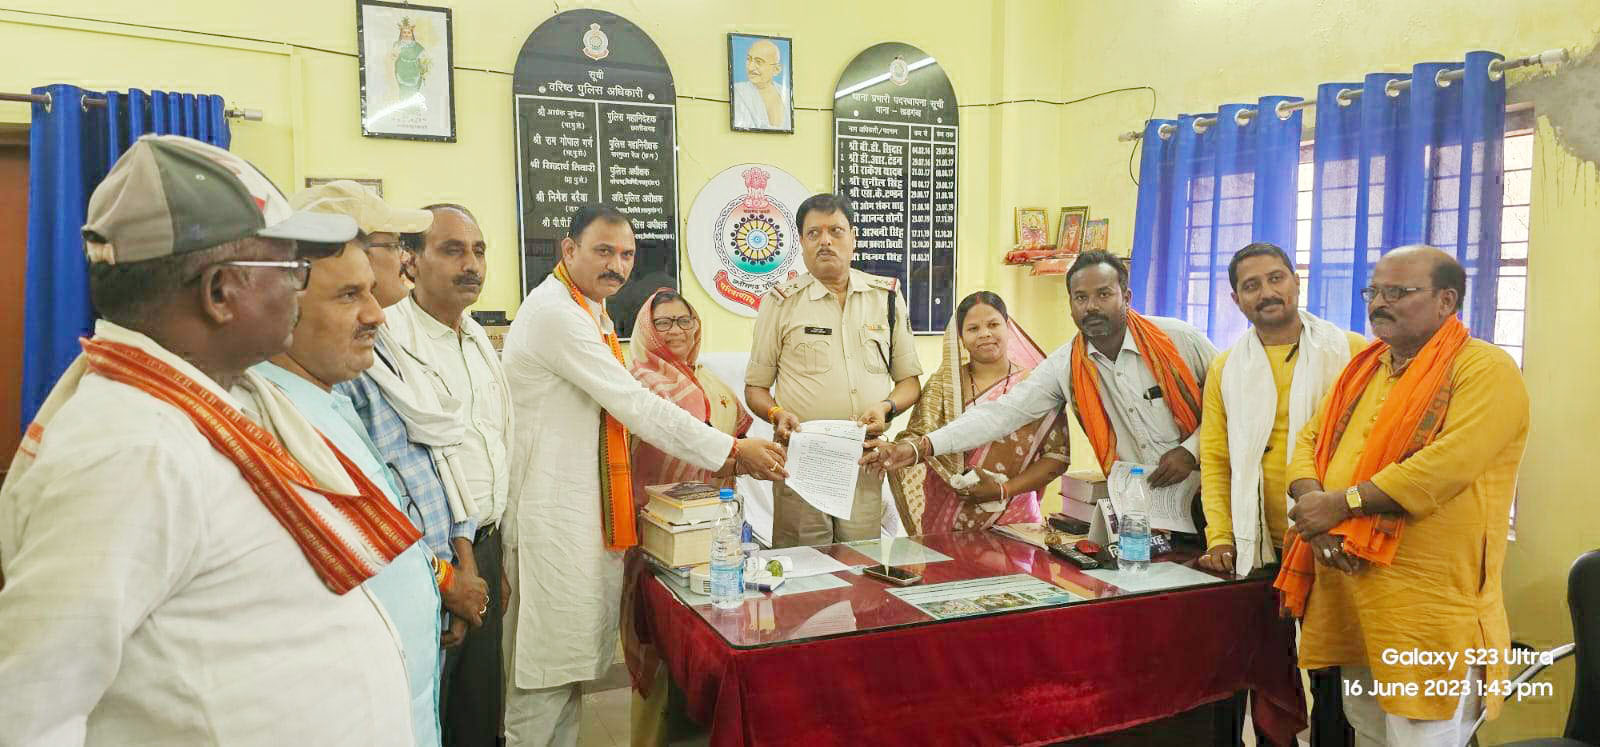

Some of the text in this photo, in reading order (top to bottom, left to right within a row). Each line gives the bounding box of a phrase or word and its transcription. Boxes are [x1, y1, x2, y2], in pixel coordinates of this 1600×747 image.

[588, 69, 604, 82] सूची
[548, 80, 643, 98] वरिष्ठ पुलिस अधिकारी
[607, 110, 624, 123] पुलिस
[609, 137, 626, 151] पुलिस
[849, 140, 859, 151] श्री
[849, 152, 859, 163] श्री
[849, 163, 859, 174] श्री
[849, 176, 860, 186] श्री
[849, 186, 860, 198] श्री
